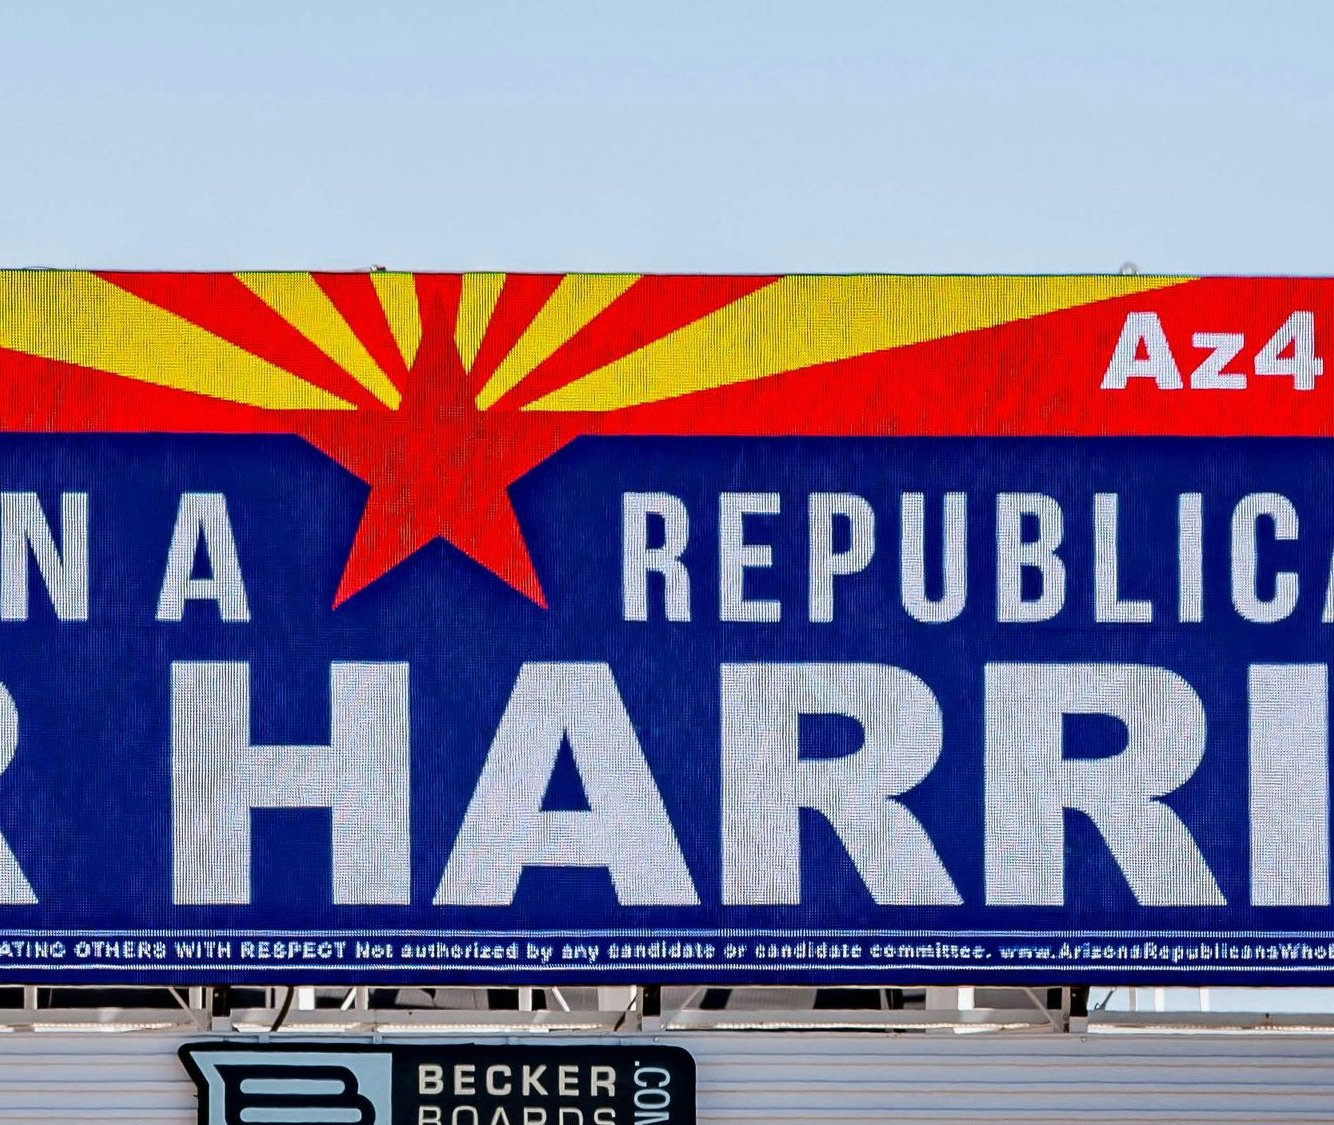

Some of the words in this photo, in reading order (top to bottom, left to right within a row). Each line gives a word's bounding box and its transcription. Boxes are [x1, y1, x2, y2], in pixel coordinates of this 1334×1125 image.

[75, 940, 166, 959] OTHERS
[175, 941, 232, 959] WITH
[240, 941, 347, 959] RESPECT
[355, 942, 394, 959] Not
[401, 942, 519, 960] authorized
[526, 942, 553, 963] by
[562, 944, 599, 963] any
[609, 942, 716, 960] candidate
[724, 944, 747, 959] or
[755, 942, 863, 960] candidate
[870, 942, 992, 960] committee.
[417, 1064, 617, 1098] BECKER
